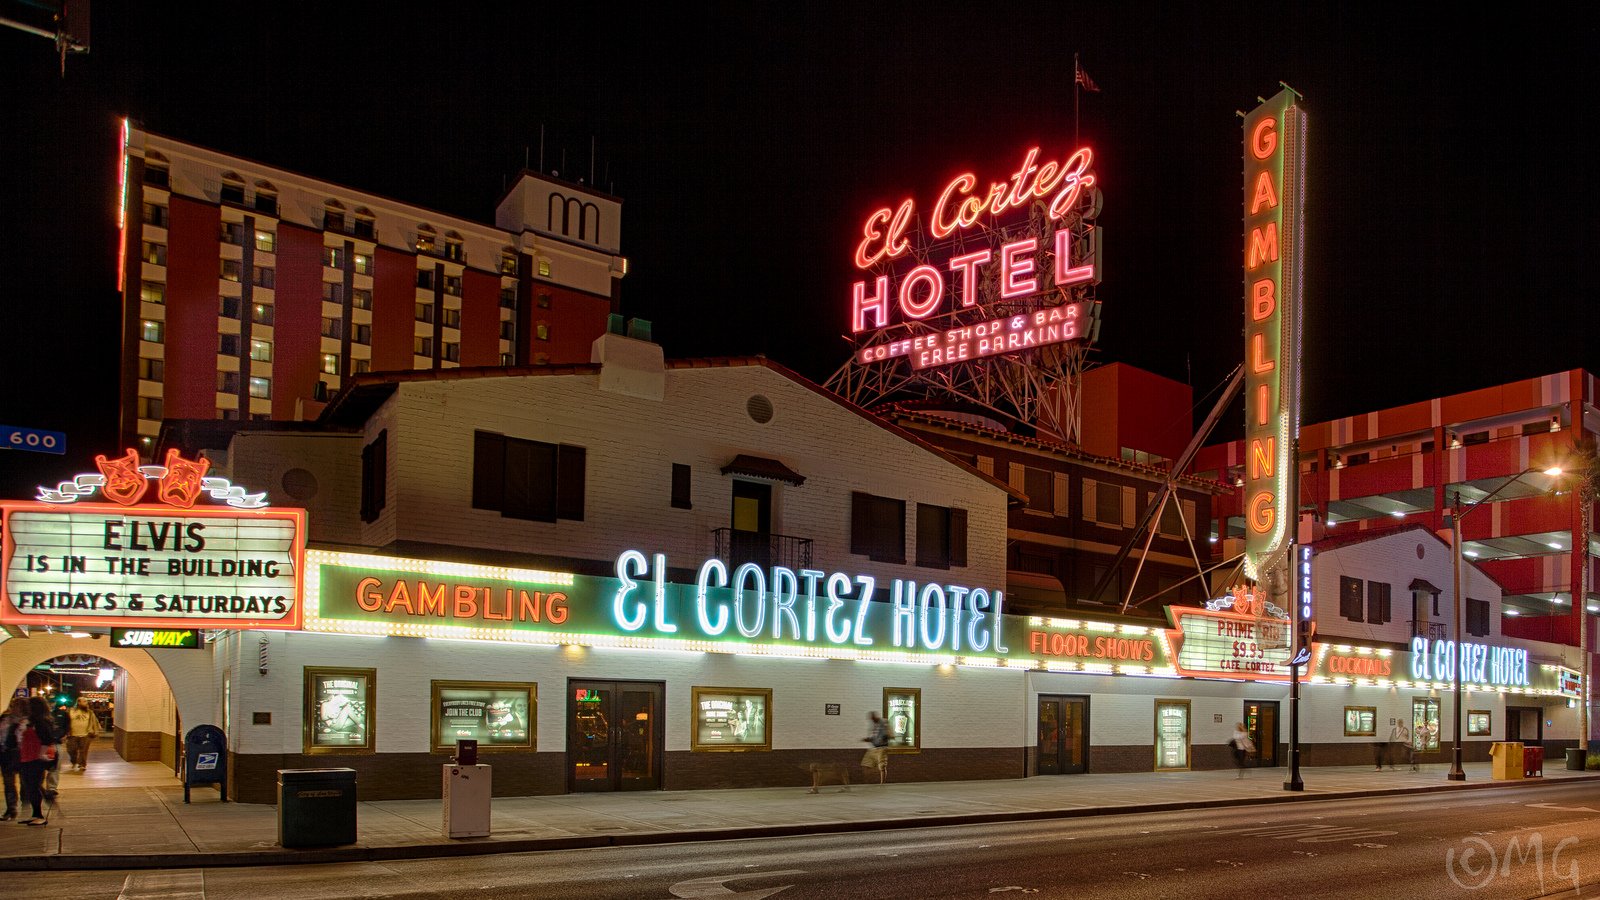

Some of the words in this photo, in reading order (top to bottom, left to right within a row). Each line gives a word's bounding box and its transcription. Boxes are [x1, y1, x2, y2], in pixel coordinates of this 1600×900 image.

[855, 199, 914, 269] El
[931, 146, 1095, 238] Cortez
[852, 228, 1094, 333] HOTEL
[863, 335, 936, 361] COFFEE
[947, 321, 1001, 343] SHOP
[1010, 315, 1026, 329] &
[1035, 304, 1078, 324] BAR
[1250, 117, 1278, 534] GAMBLING
[920, 342, 968, 367] FREE
[979, 321, 1076, 352] PARKING
[9, 432, 56, 448] 600
[104, 520, 206, 552] ELVIS
[27, 555, 49, 573] IS
[63, 556, 86, 574] IN
[105, 557, 150, 576] THE
[167, 559, 280, 577] BUILDING
[18, 591, 117, 611] FRIDAYS
[128, 594, 144, 611] &
[153, 594, 287, 614] SATURDAYS
[356, 577, 568, 624] GAMBLING
[613, 549, 677, 633] EL
[697, 558, 875, 645] CORTEZ
[893, 578, 1009, 654] HOTEL
[119, 630, 192, 646] SUBWAY
[1218, 620, 1254, 639] PRIME
[1030, 631, 1089, 656] FLOOR
[1095, 637, 1154, 661] SHOWS
[1412, 637, 1431, 679] EL
[1492, 646, 1529, 685] HOTEL
[1220, 660, 1240, 669] CAFE
[1246, 661, 1275, 672] CORTEZ
[1329, 655, 1391, 676] COCKTAILS
[445, 708, 459, 717] JOIN
[459, 708, 468, 717] THE
